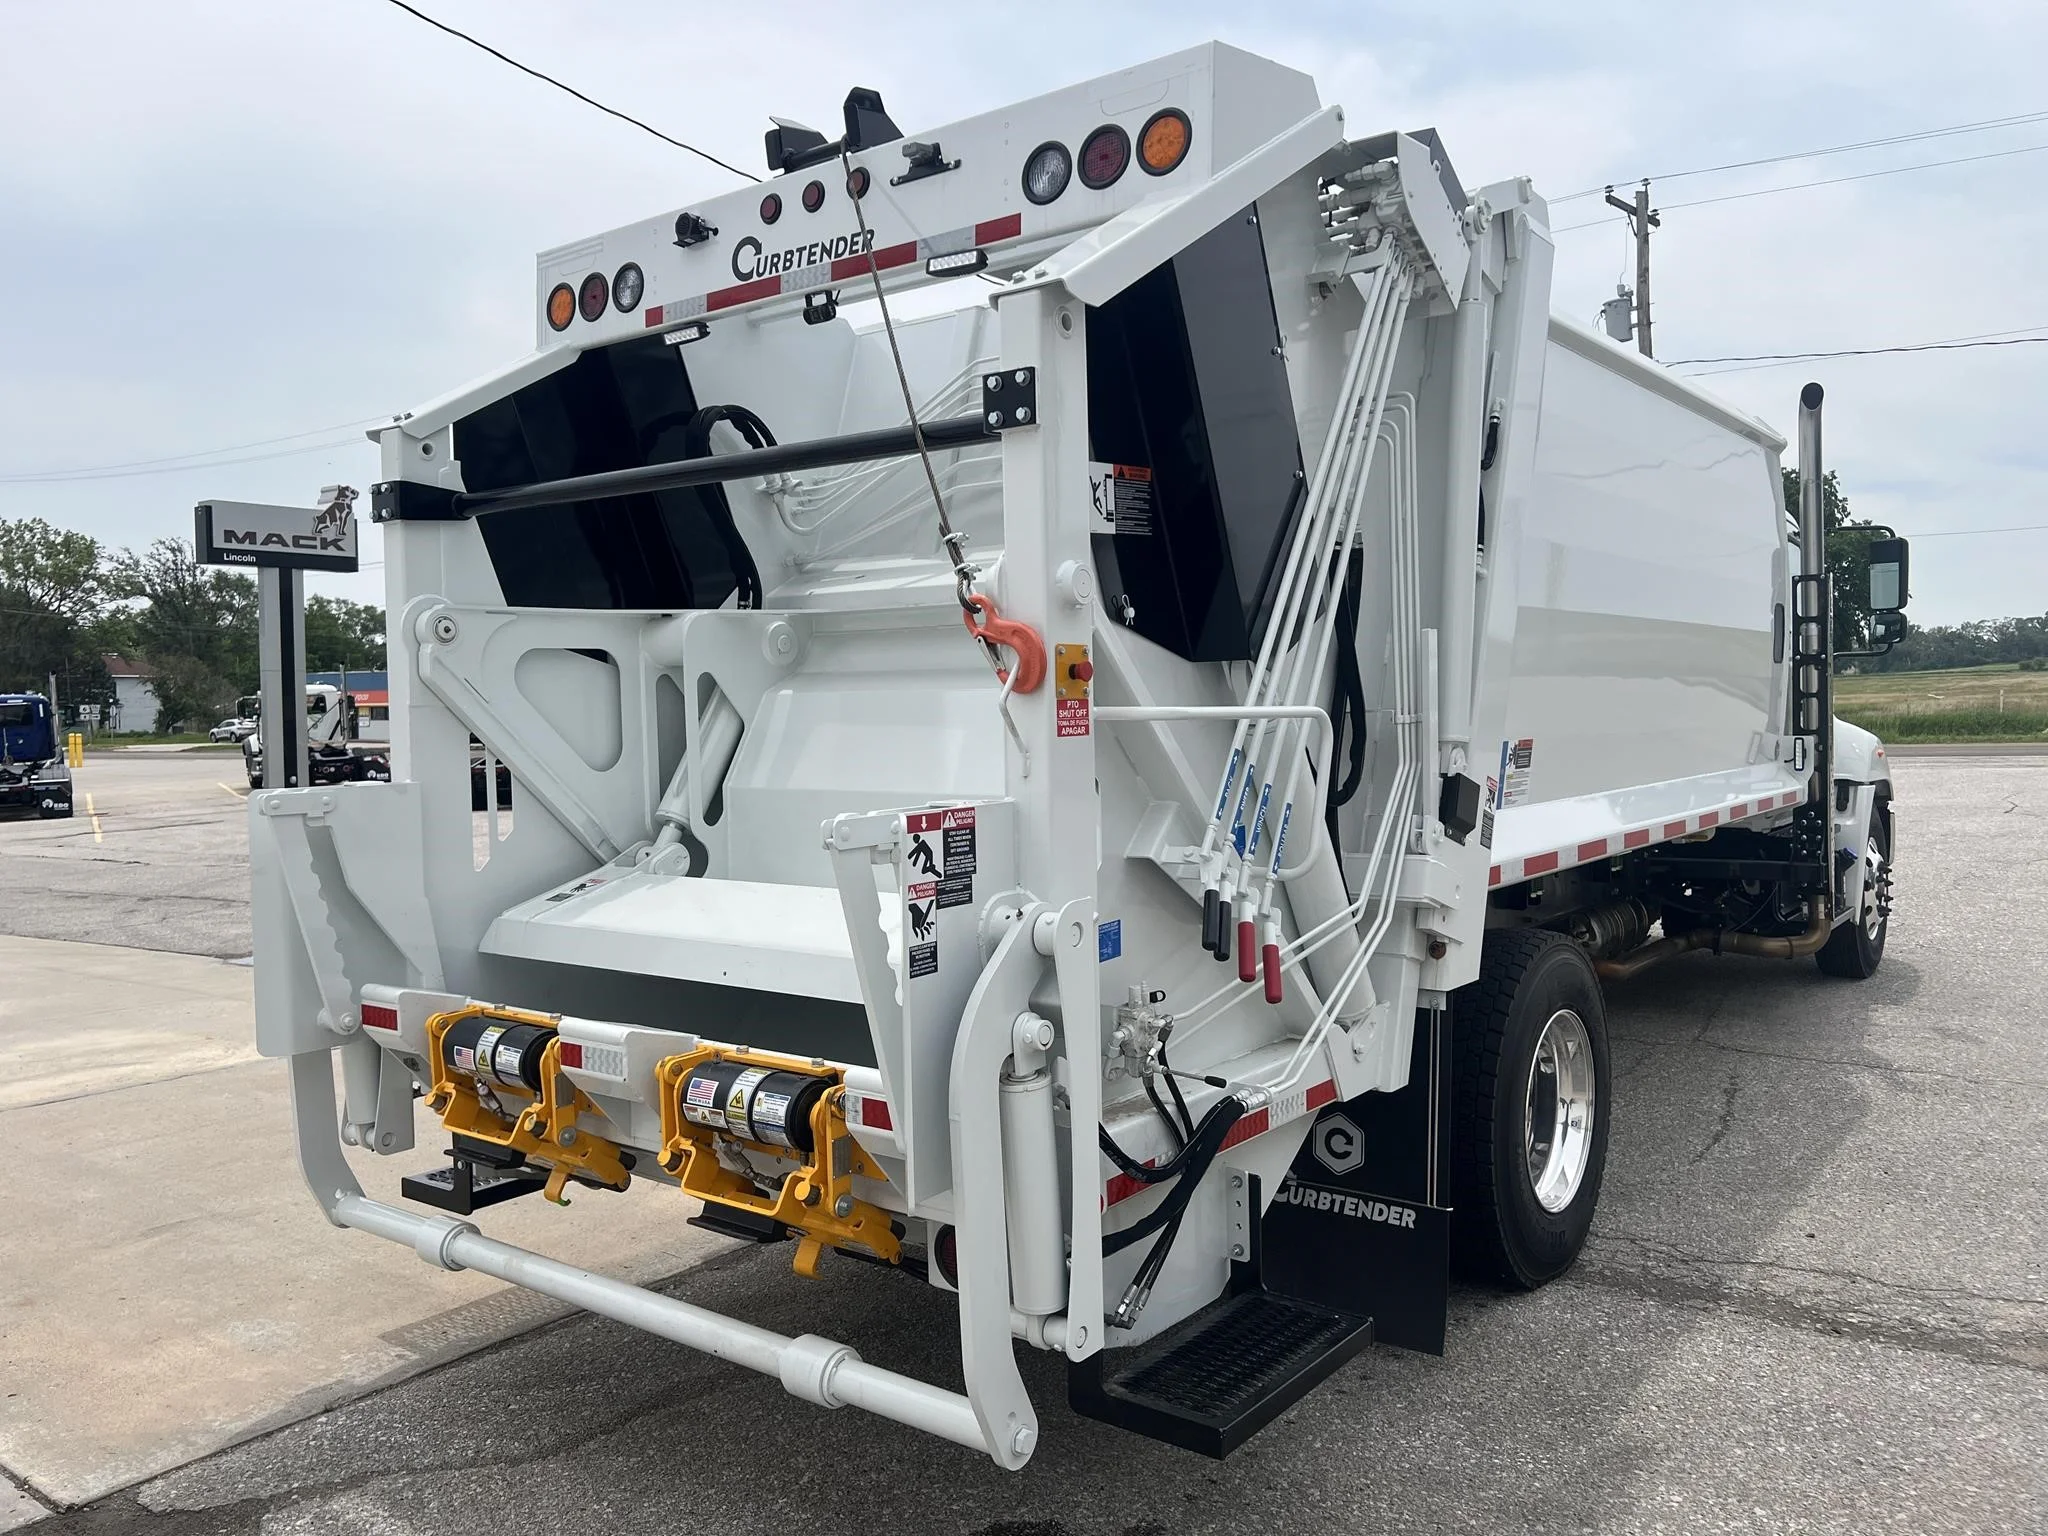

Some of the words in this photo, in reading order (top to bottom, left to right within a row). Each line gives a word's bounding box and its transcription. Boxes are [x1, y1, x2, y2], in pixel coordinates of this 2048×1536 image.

[732, 228, 875, 282] CURBTENDER
[223, 529, 346, 552] MACK
[223, 552, 256, 564] Lincoln
[1066, 700, 1079, 709] PTO
[1058, 709, 1075, 718] SHUT
[1075, 708, 1088, 718] OFF
[1061, 726, 1086, 735] APAGAR
[953, 810, 976, 819] DANGER
[1255, 805, 1267, 833] WINCH
[916, 881, 936, 891] DANGER
[916, 889, 935, 898] PELIGRO
